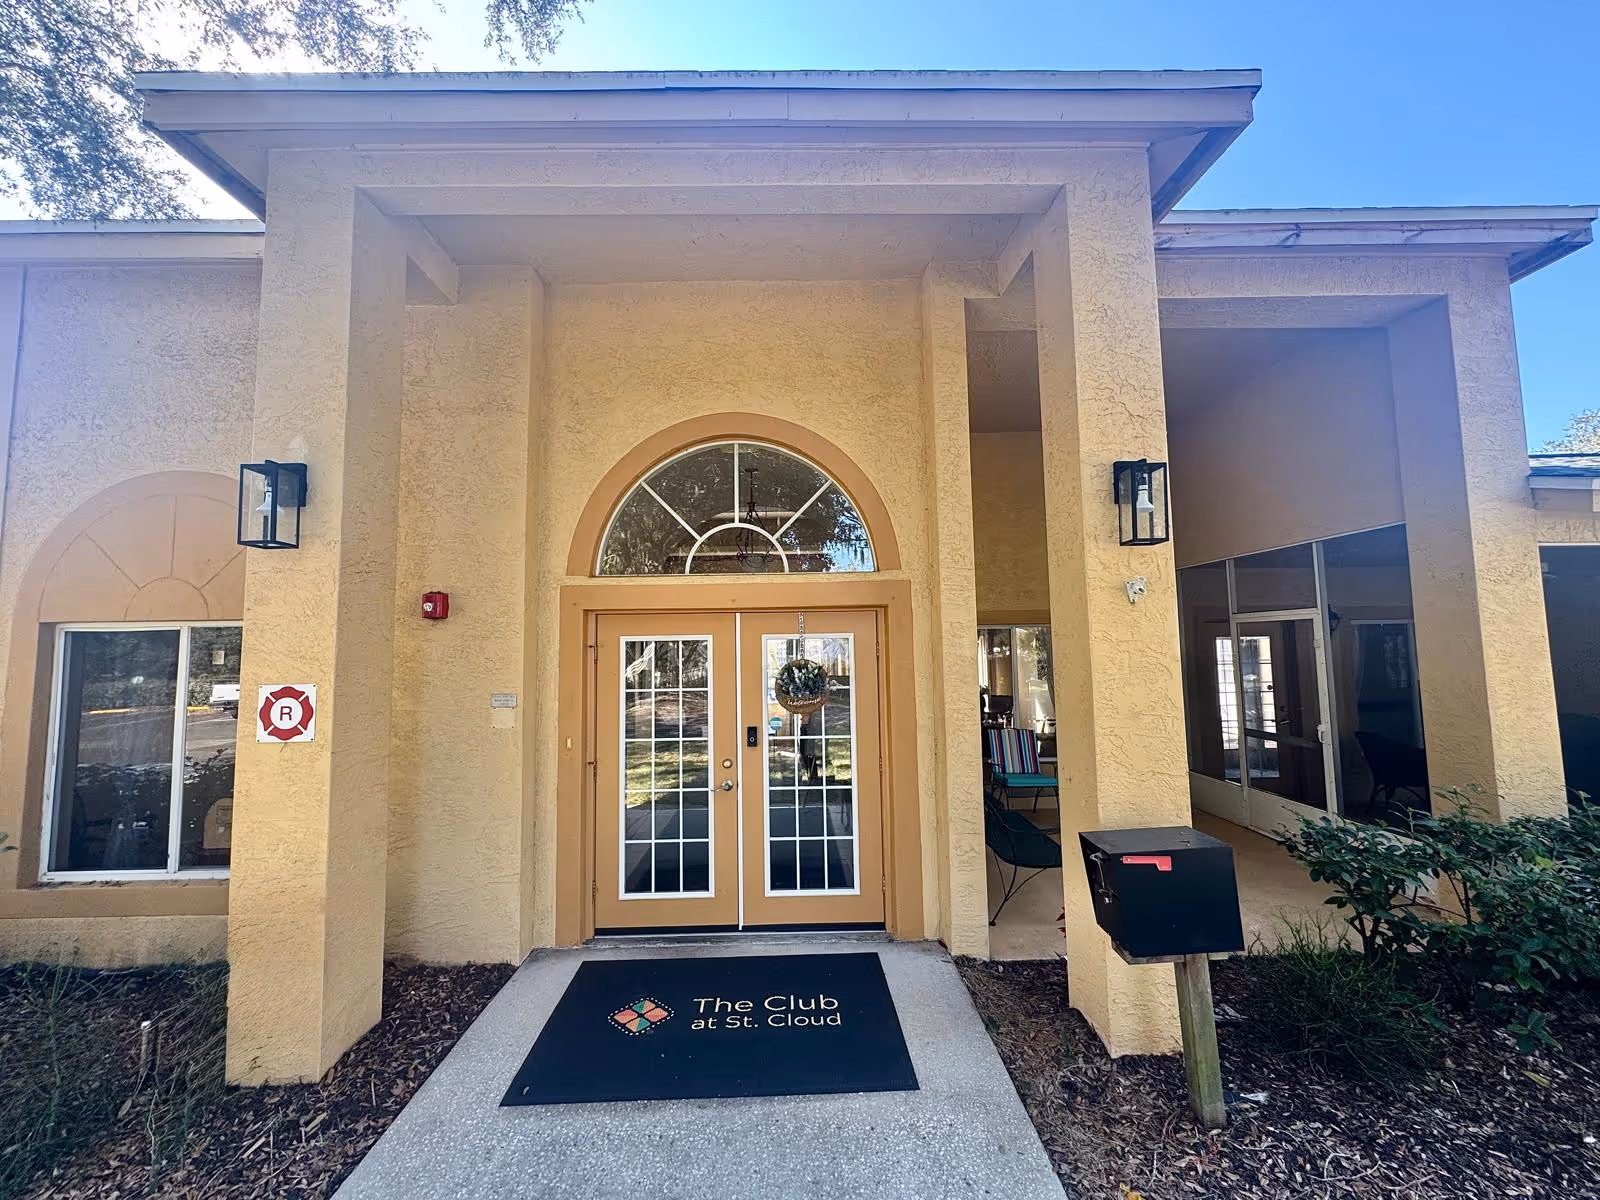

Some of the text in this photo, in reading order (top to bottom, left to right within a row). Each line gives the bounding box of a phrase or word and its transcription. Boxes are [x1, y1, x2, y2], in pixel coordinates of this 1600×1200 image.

[279, 705, 293, 721] R
[692, 994, 839, 1014] The Club
[691, 1012, 842, 1030] at St. Cloud
